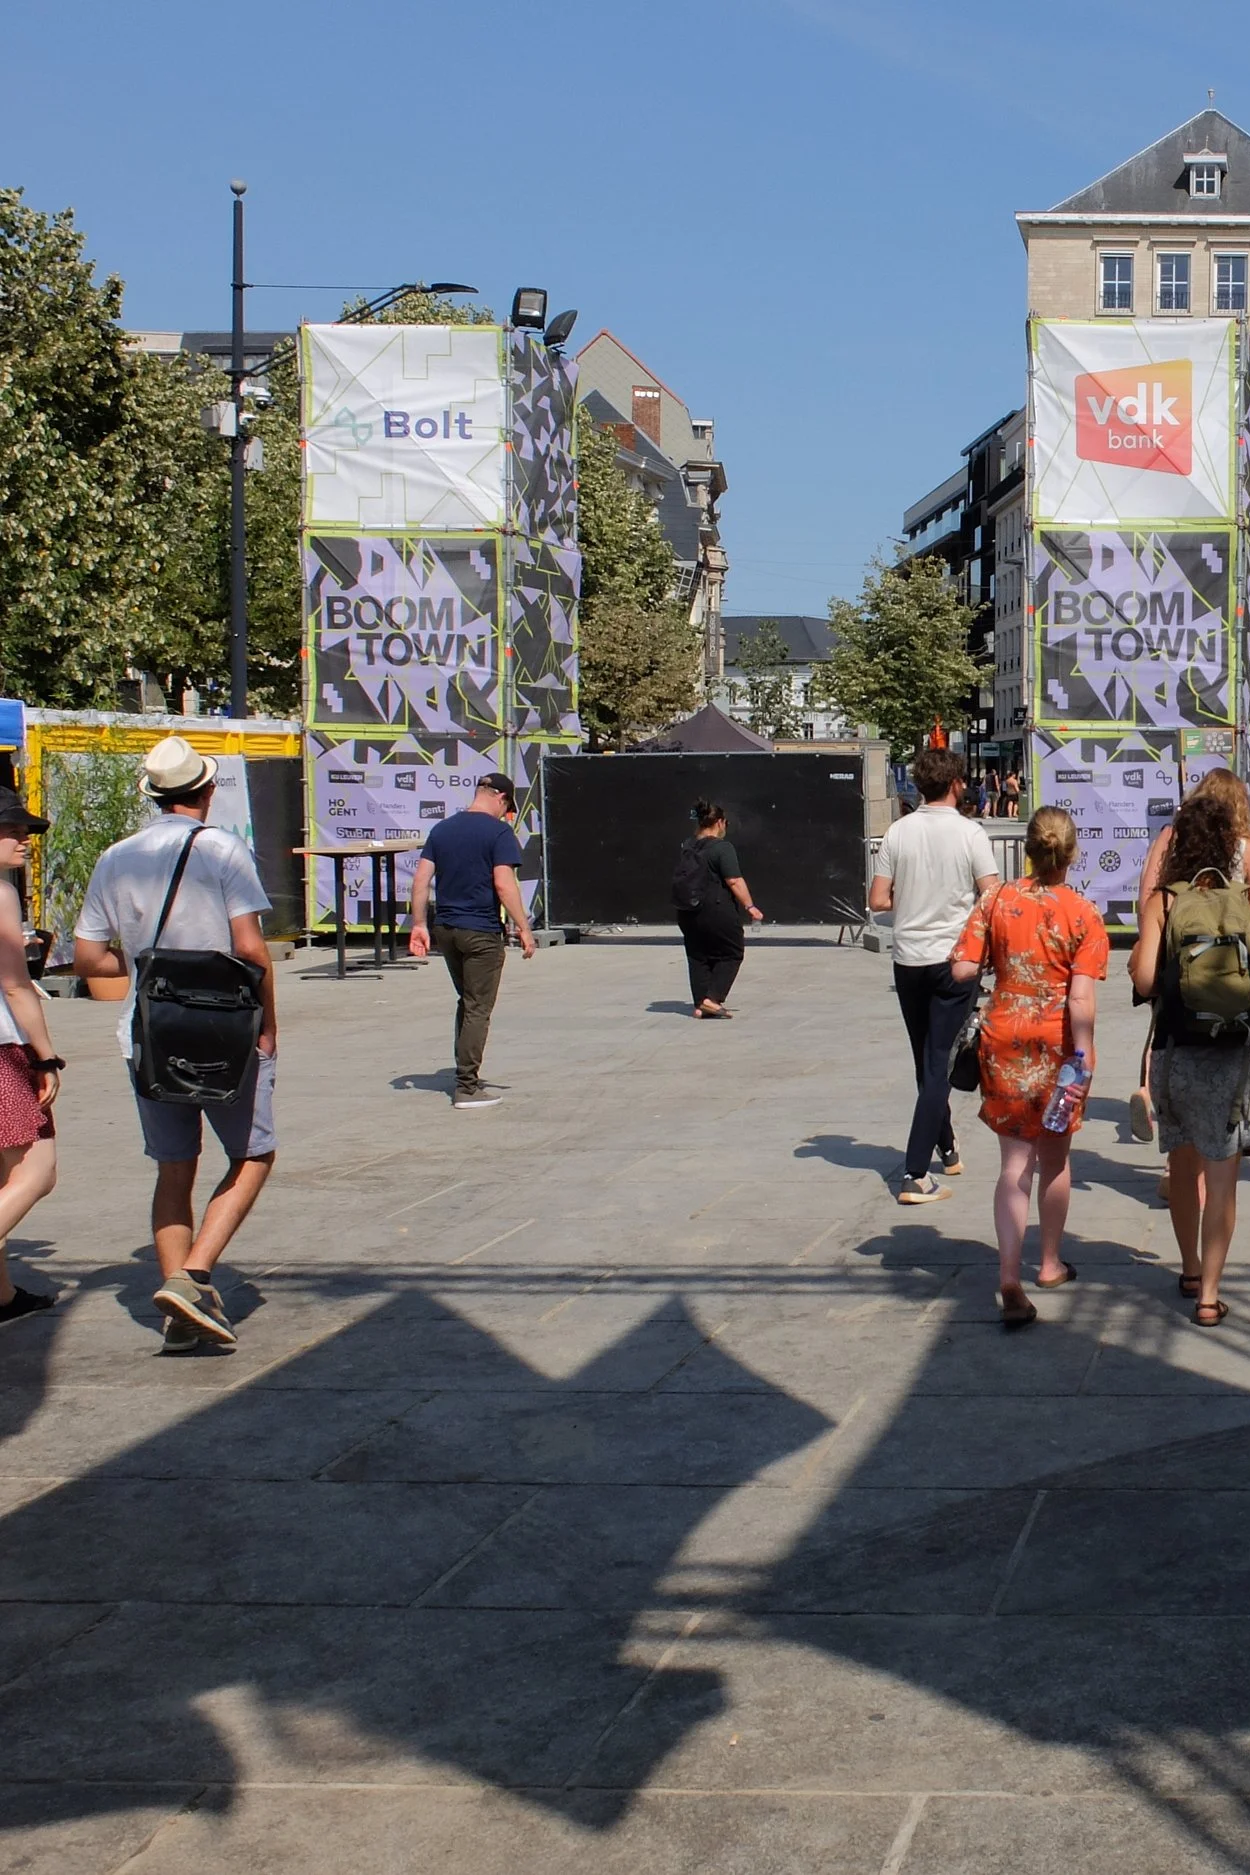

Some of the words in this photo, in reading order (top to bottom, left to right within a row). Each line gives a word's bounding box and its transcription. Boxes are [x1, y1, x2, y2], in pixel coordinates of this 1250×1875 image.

[1086, 382, 1181, 426] vdk
[384, 410, 473, 440] Bolt
[1108, 428, 1165, 449] bank
[327, 595, 455, 631] BOOM
[1055, 590, 1185, 626] BOOM
[357, 632, 487, 668] TOWN
[1084, 627, 1219, 662] TOWN
[396, 774, 414, 784] vdk
[450, 775, 477, 787] Bol
[1124, 771, 1142, 781] vdk
[329, 799, 345, 807] HO
[1055, 799, 1072, 807] HO
[329, 808, 358, 816] GENT
[336, 828, 375, 839] StuBru
[386, 829, 419, 839] HUMO
[1077, 828, 1102, 838] uBru
[1114, 828, 1149, 838] HUMO
